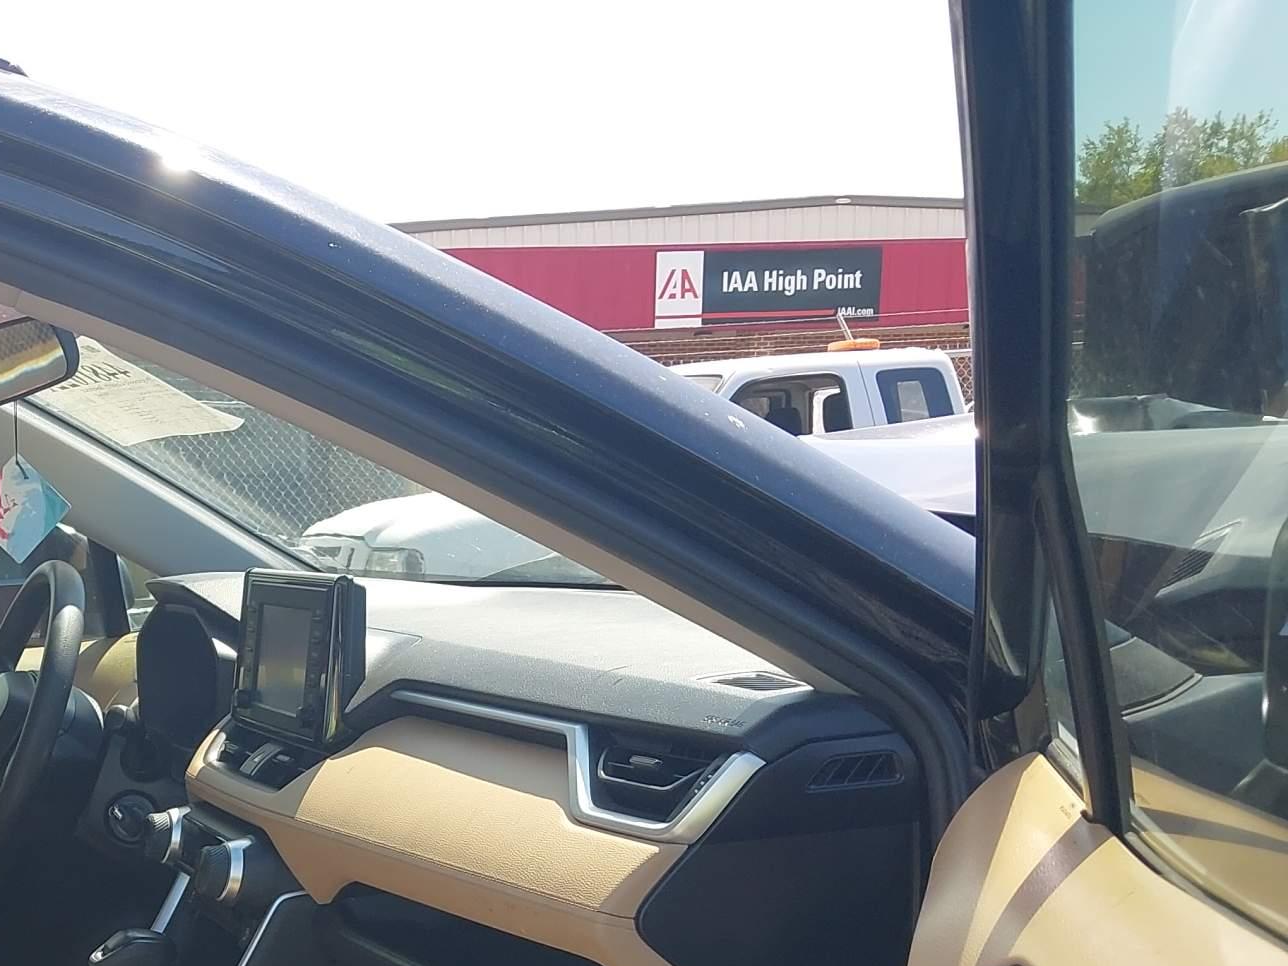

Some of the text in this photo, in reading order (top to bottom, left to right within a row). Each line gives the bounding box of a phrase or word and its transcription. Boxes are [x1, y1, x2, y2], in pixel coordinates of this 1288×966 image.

[722, 267, 863, 296] IAA High Point
